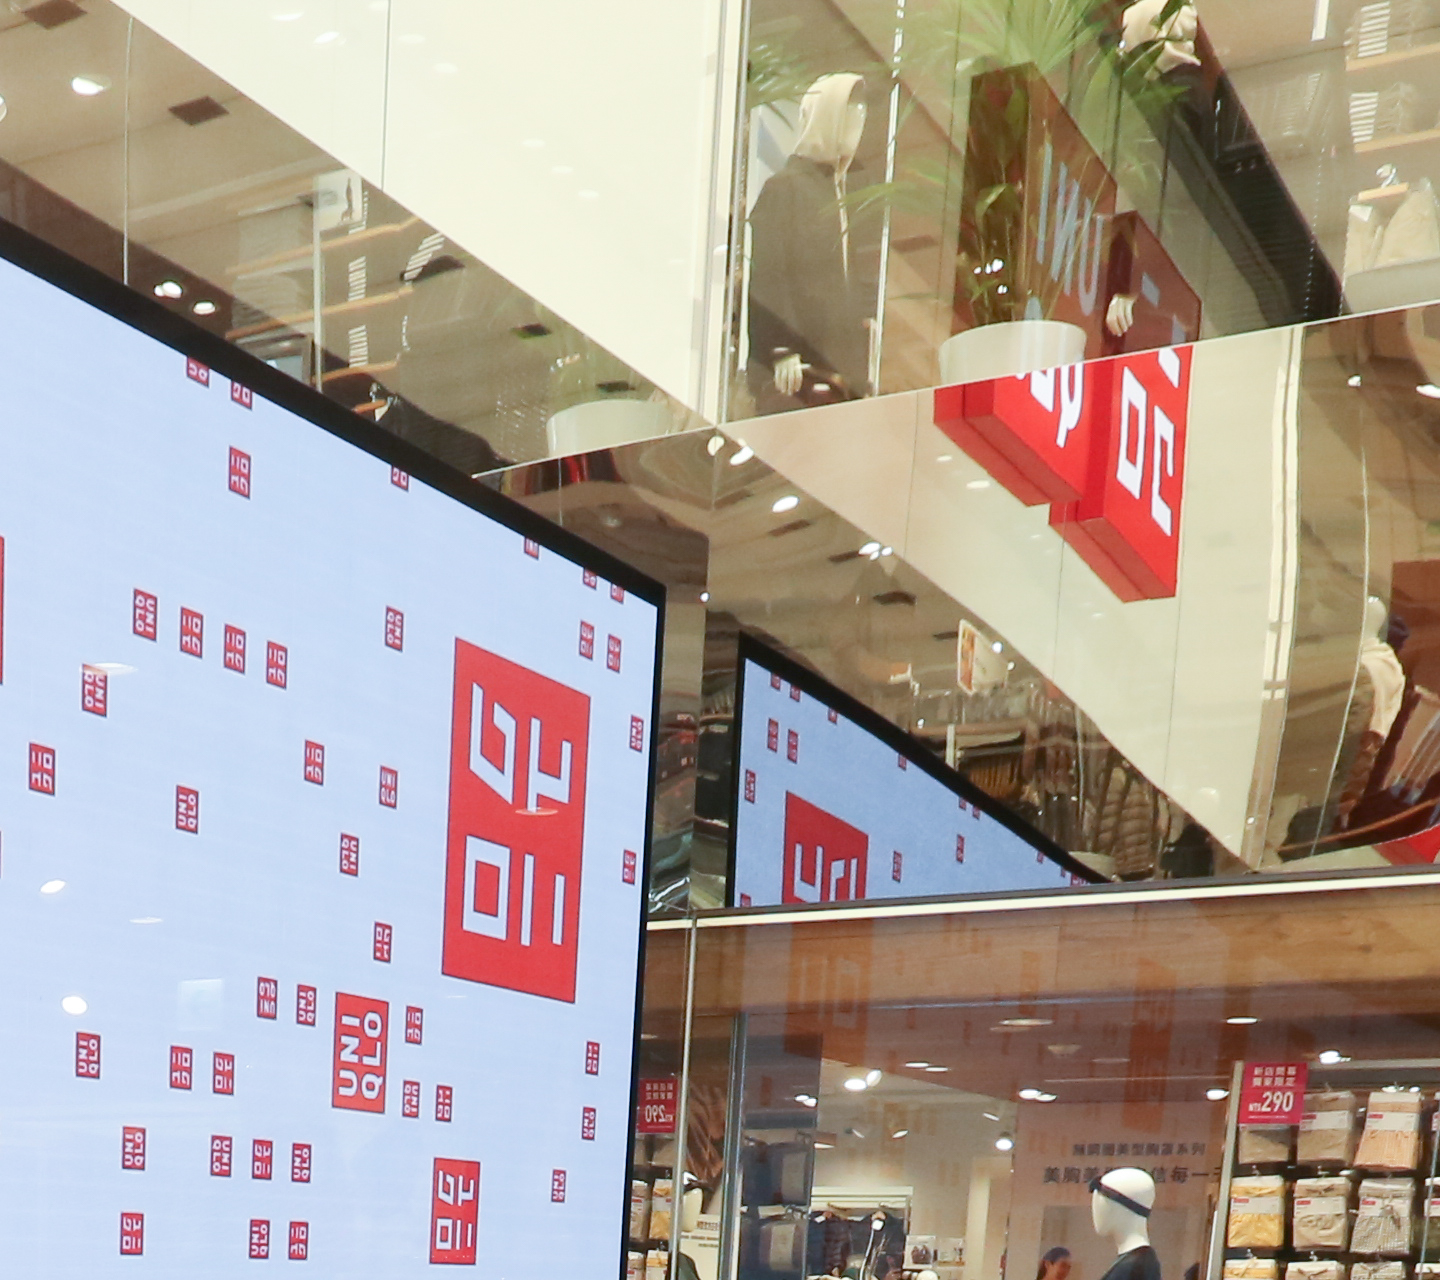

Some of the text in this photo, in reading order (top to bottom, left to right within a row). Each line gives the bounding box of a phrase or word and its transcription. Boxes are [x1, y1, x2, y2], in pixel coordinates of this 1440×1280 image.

[463, 685, 518, 938] クロ
[520, 718, 572, 945] ユニ
[339, 1017, 360, 1097] UNI
[360, 1011, 383, 1098] QLO
[437, 1173, 454, 1249] クロ
[456, 1175, 473, 1248] ユニ
